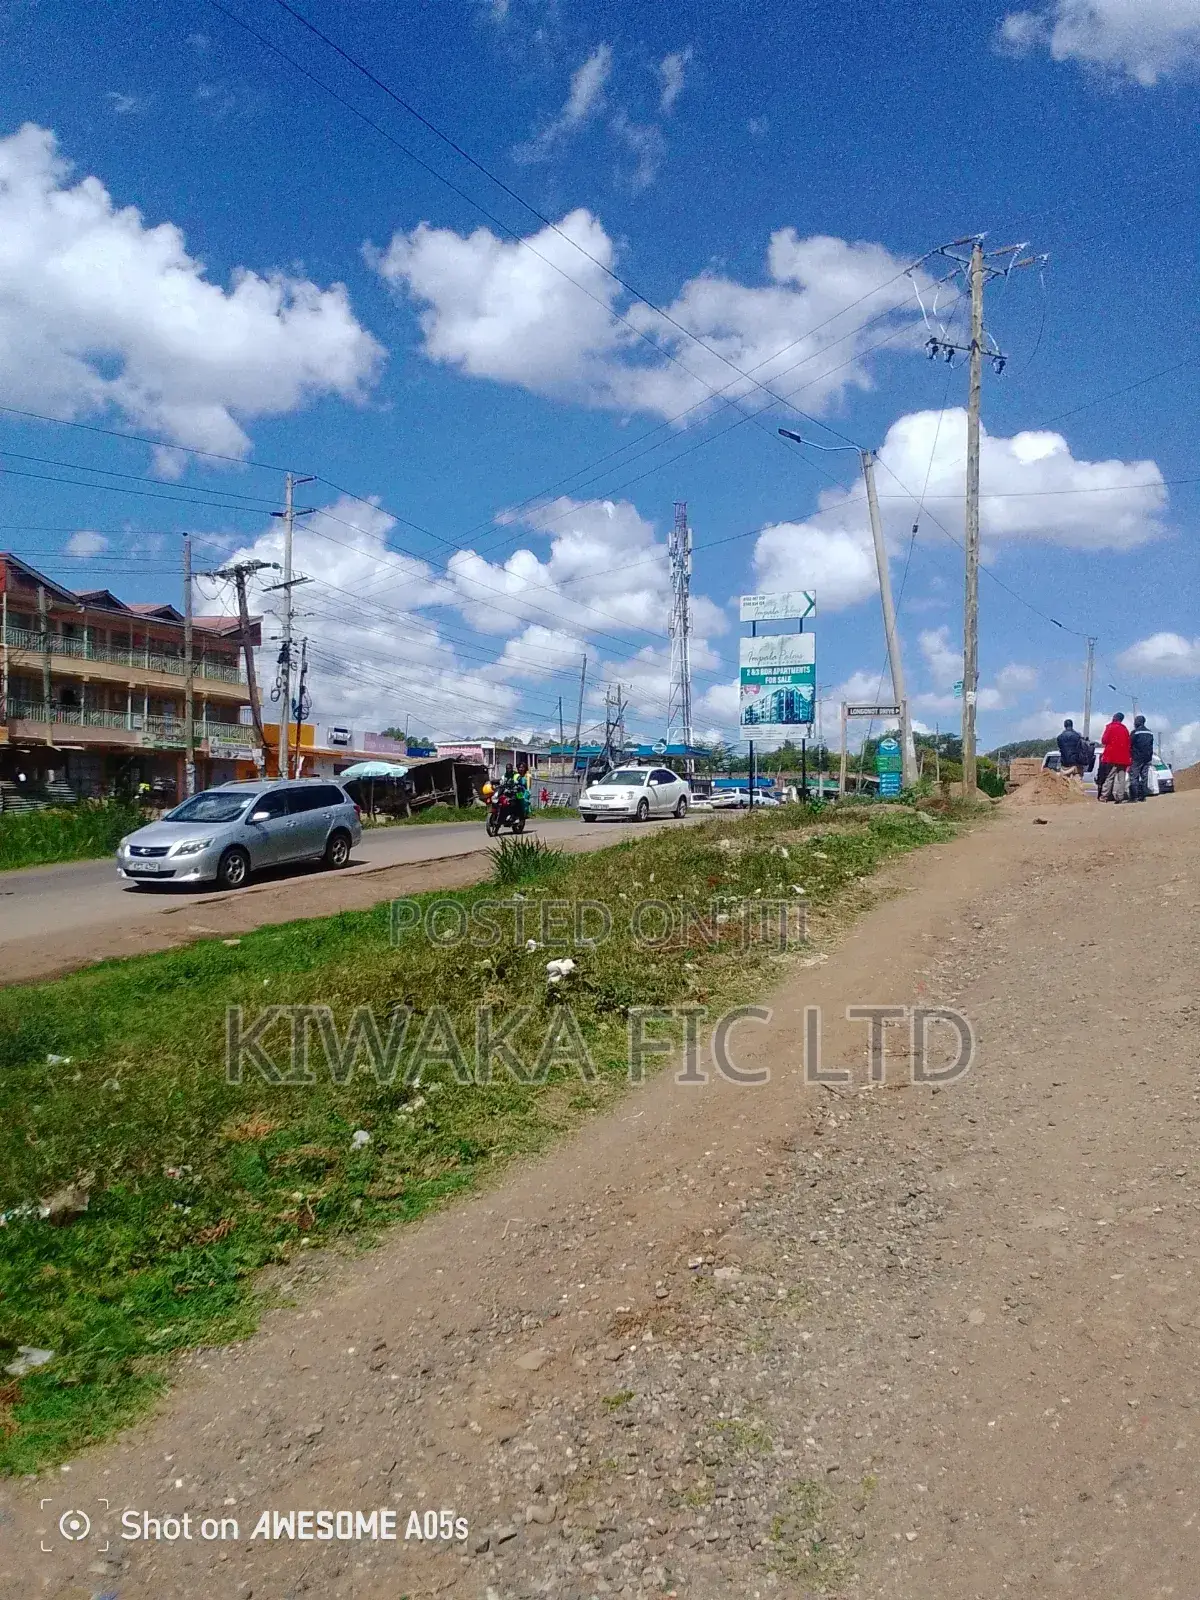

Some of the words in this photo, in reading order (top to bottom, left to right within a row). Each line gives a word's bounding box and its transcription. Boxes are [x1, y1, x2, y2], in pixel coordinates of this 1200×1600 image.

[748, 650, 777, 666] Impala
[773, 666, 811, 675] APARTMENTS
[765, 676, 777, 684] FOR
[777, 675, 792, 683] SALE
